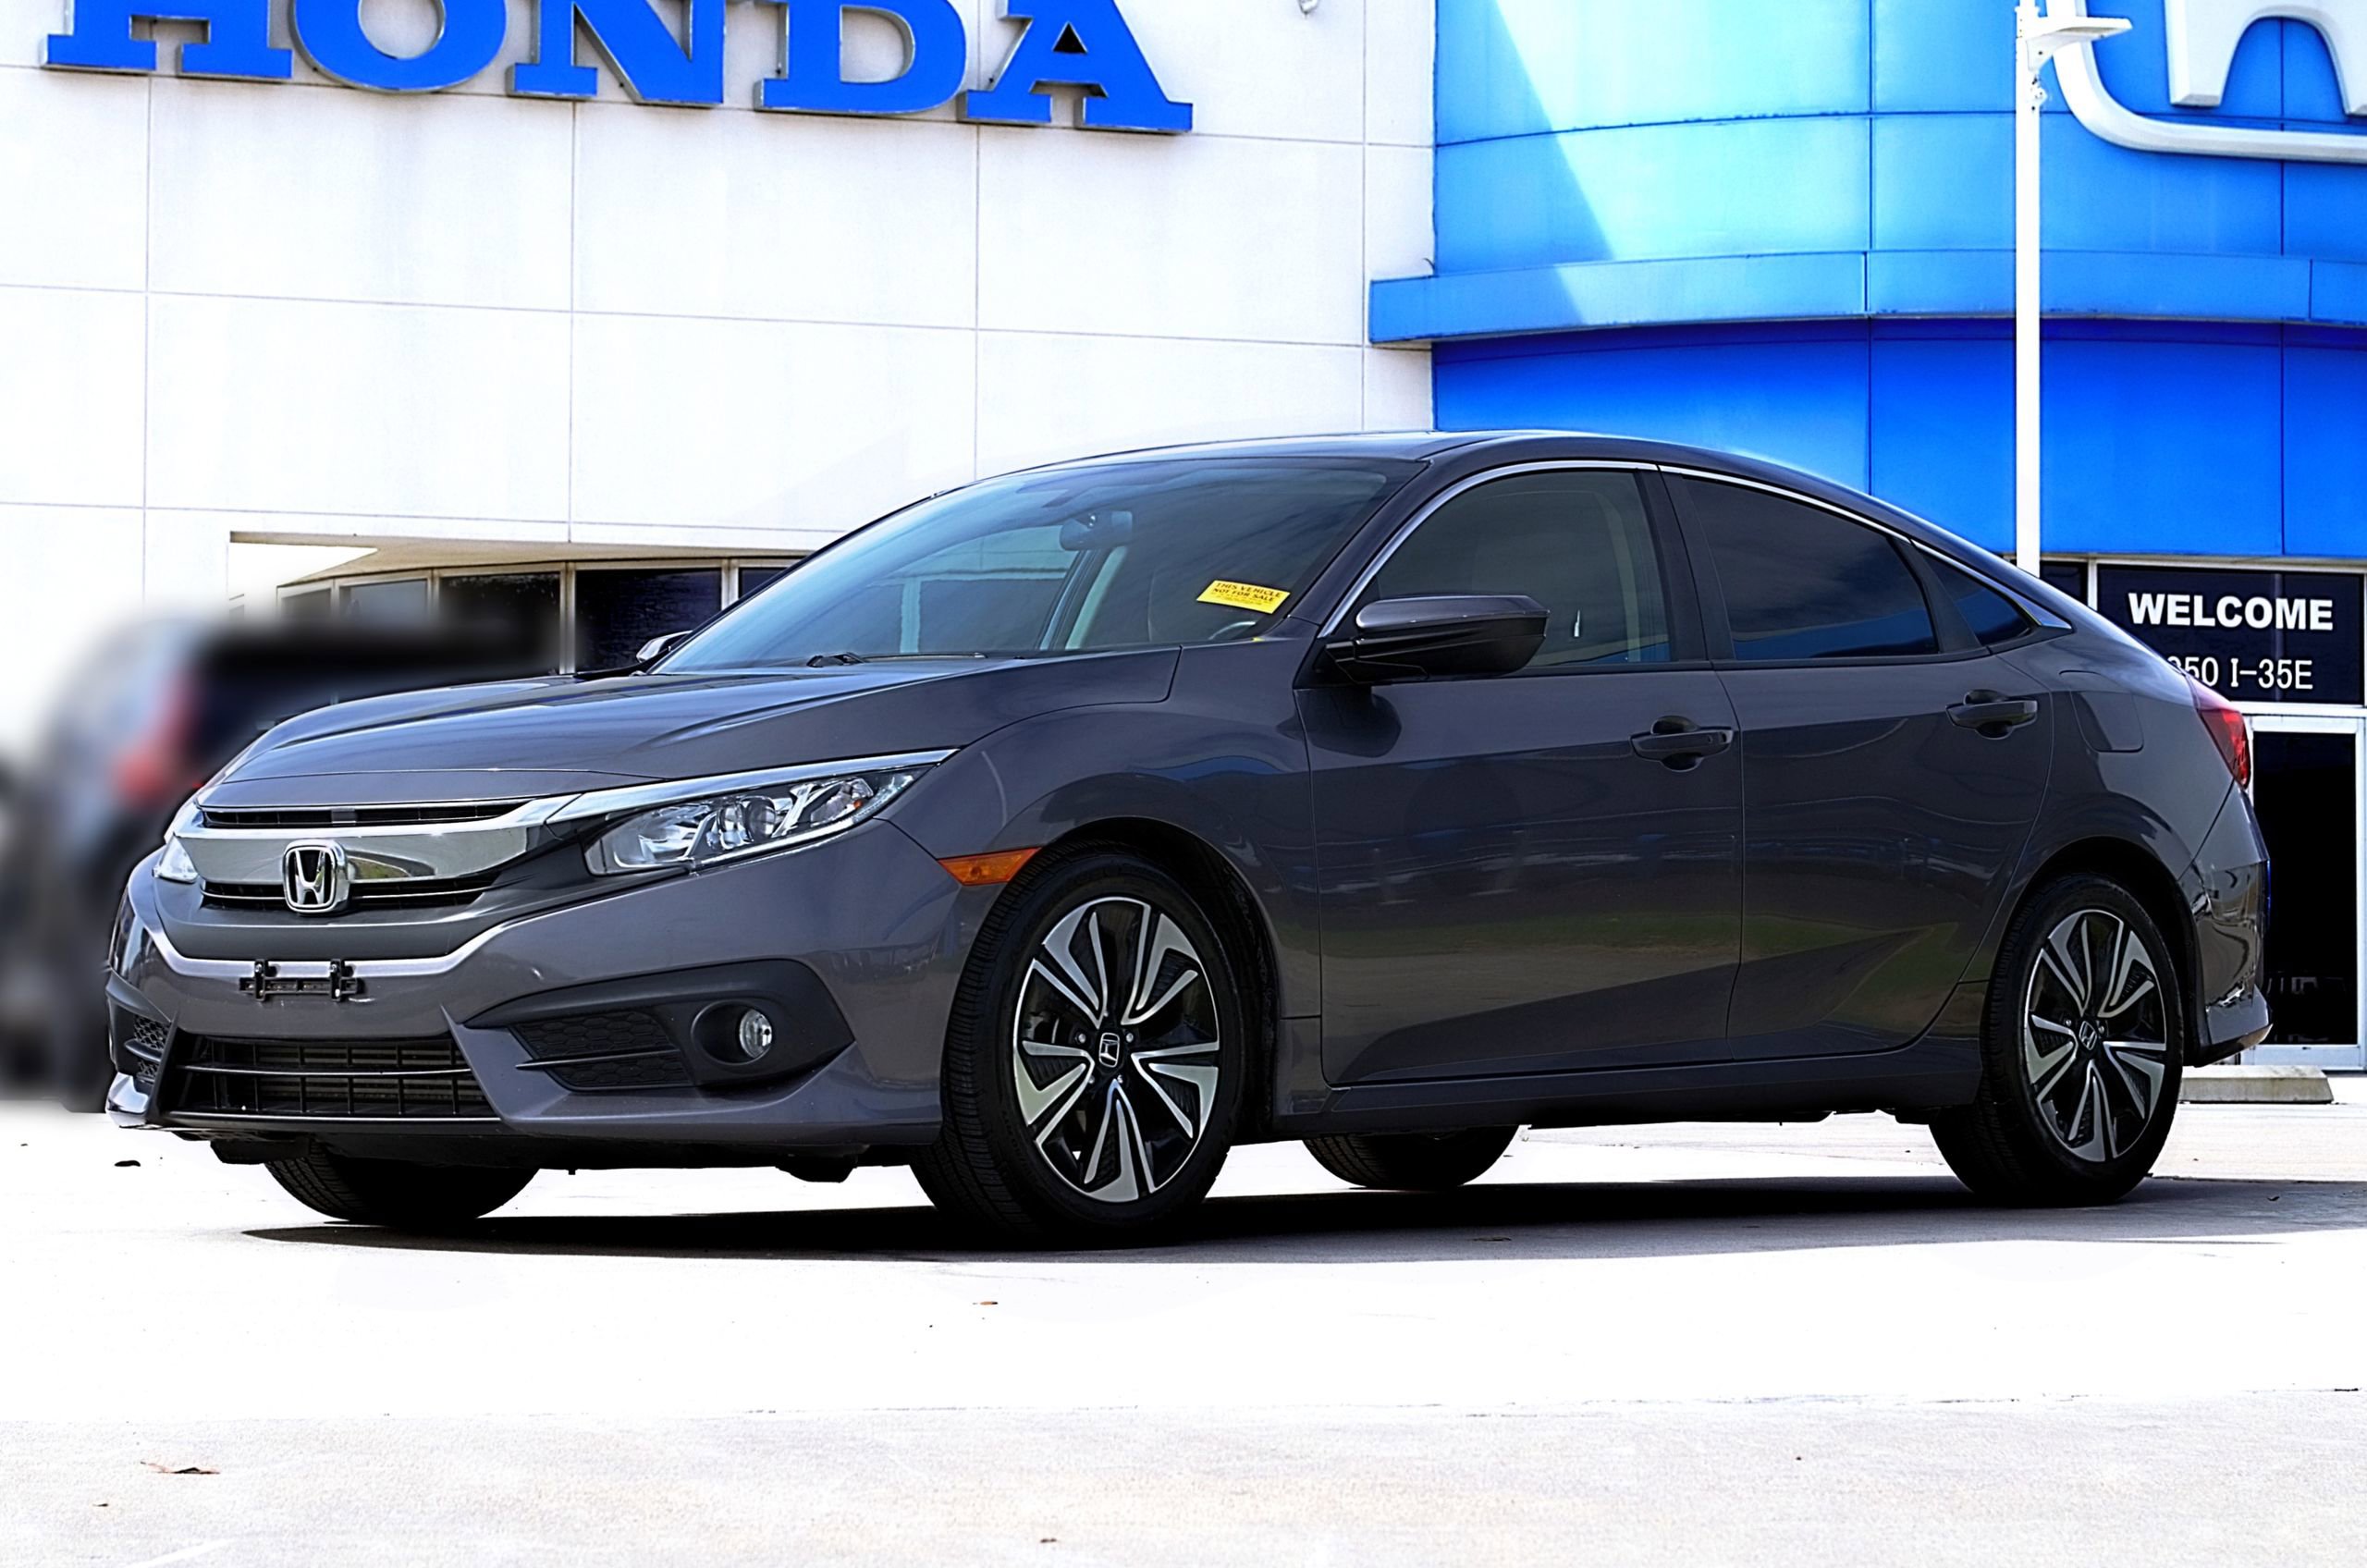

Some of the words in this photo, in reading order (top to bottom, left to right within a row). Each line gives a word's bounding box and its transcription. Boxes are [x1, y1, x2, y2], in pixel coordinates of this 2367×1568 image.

[41, 0, 1195, 135] HONDA
[1241, 585, 1283, 598] VEHICLE
[1253, 594, 1275, 602] SALE
[2128, 592, 2335, 631] WELCOME
[2230, 657, 2313, 690] I-35E
